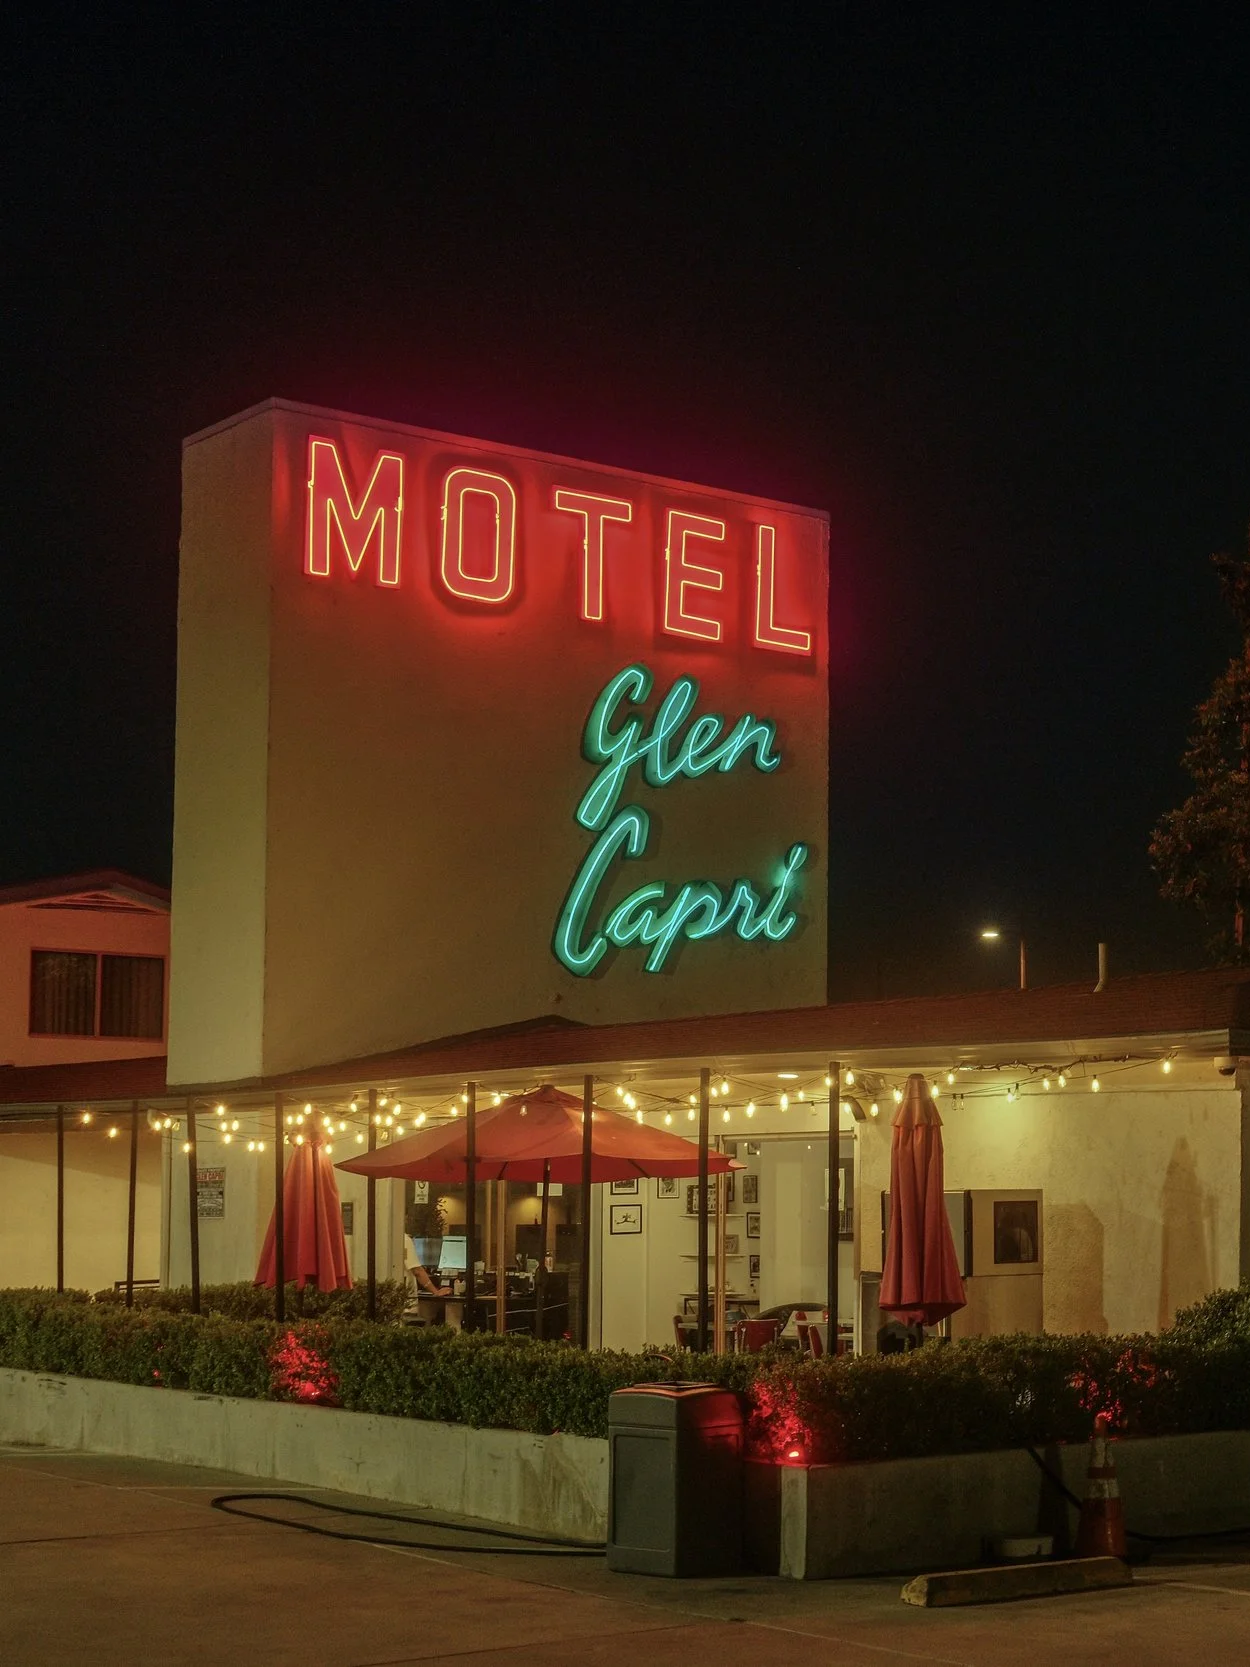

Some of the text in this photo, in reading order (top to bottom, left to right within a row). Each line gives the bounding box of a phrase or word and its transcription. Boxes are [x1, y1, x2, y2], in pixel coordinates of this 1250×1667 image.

[305, 435, 811, 656] MOTEL
[575, 663, 780, 830] Glen
[552, 804, 807, 977] Capri
